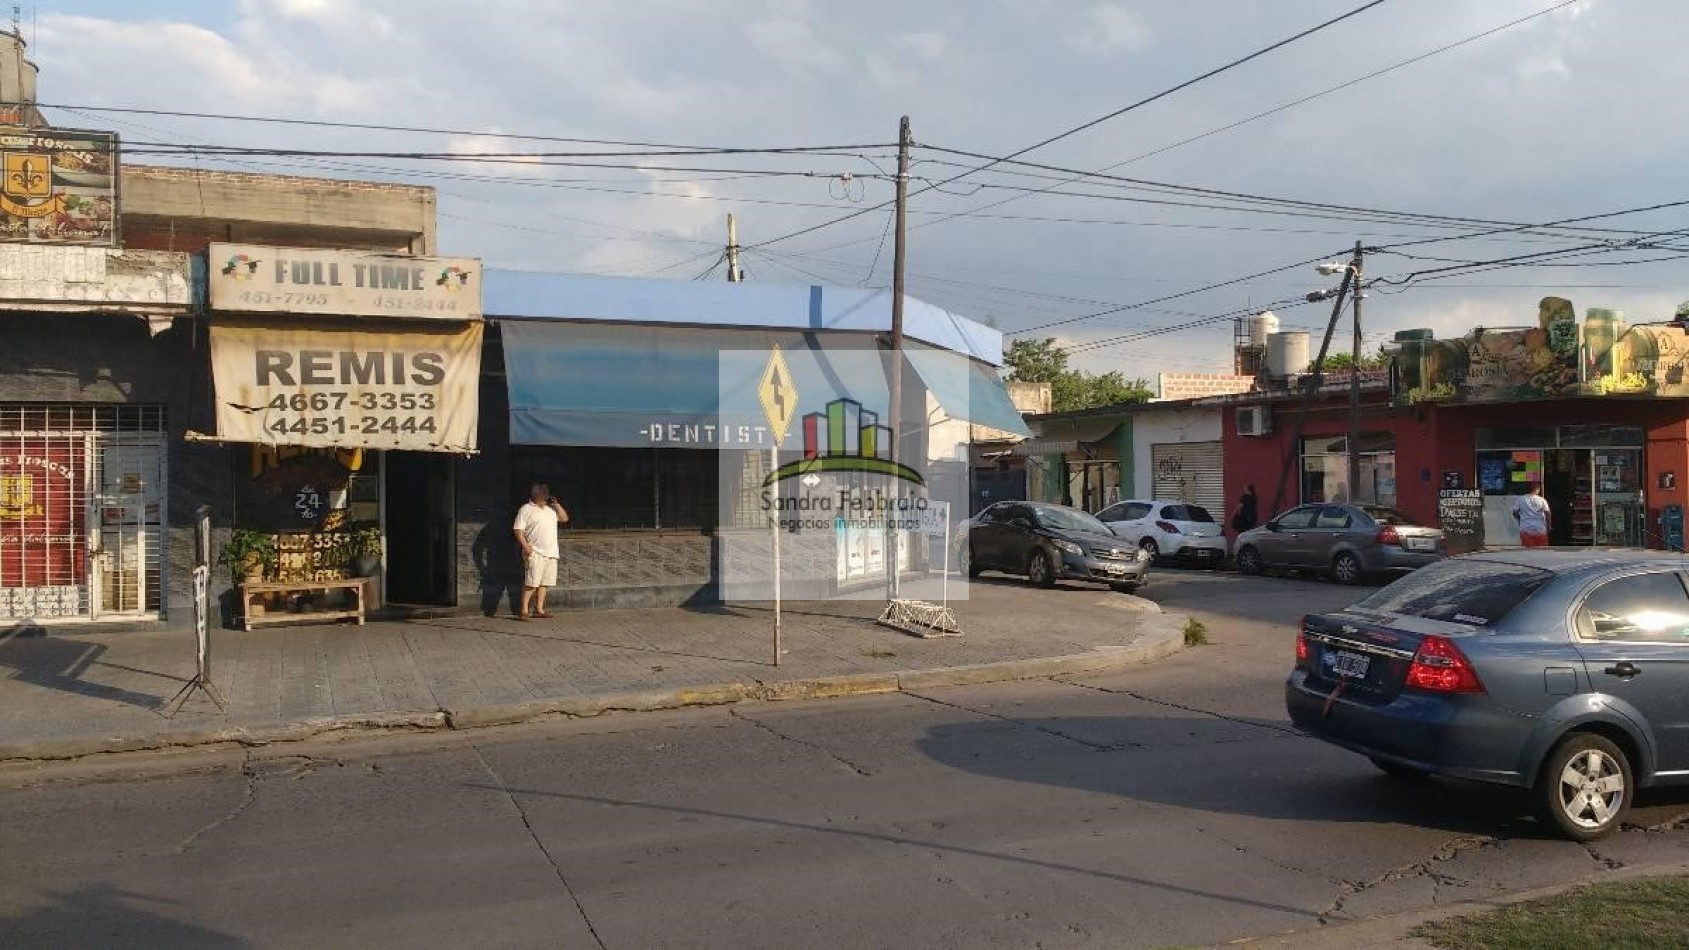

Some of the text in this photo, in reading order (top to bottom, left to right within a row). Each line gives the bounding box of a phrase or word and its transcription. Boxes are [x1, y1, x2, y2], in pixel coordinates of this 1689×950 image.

[275, 259, 425, 291] FULL TIME
[255, 350, 446, 387] REMIS
[268, 392, 436, 412] 4667-3353
[269, 416, 437, 435] 4451-2444
[295, 493, 319, 509] 24
